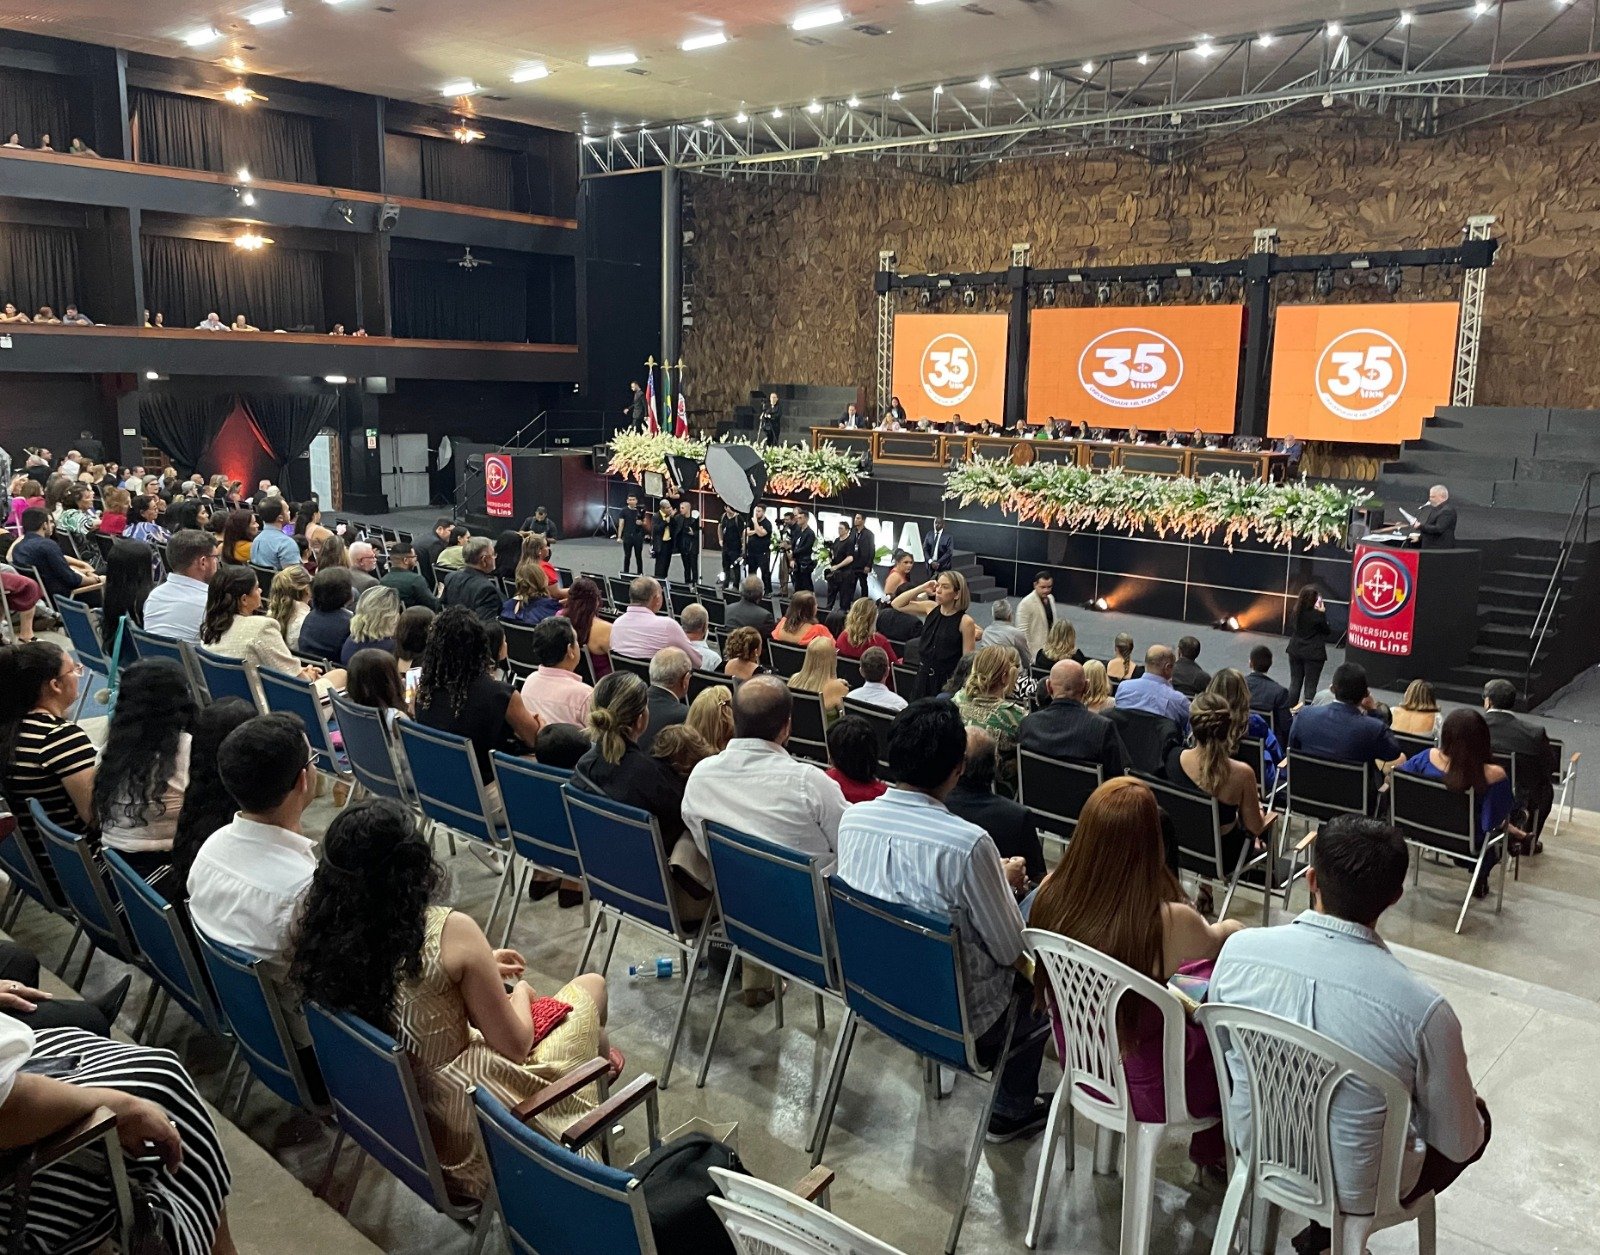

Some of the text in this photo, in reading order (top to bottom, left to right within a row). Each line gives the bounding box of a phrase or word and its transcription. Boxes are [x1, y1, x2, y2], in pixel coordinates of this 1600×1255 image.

[928, 347, 969, 387] 35
[1092, 343, 1167, 387] 35
[1327, 345, 1393, 397] 35
[1348, 633, 1408, 653] Nilton Lins
[1349, 623, 1408, 640] UNIVERSIDADE
